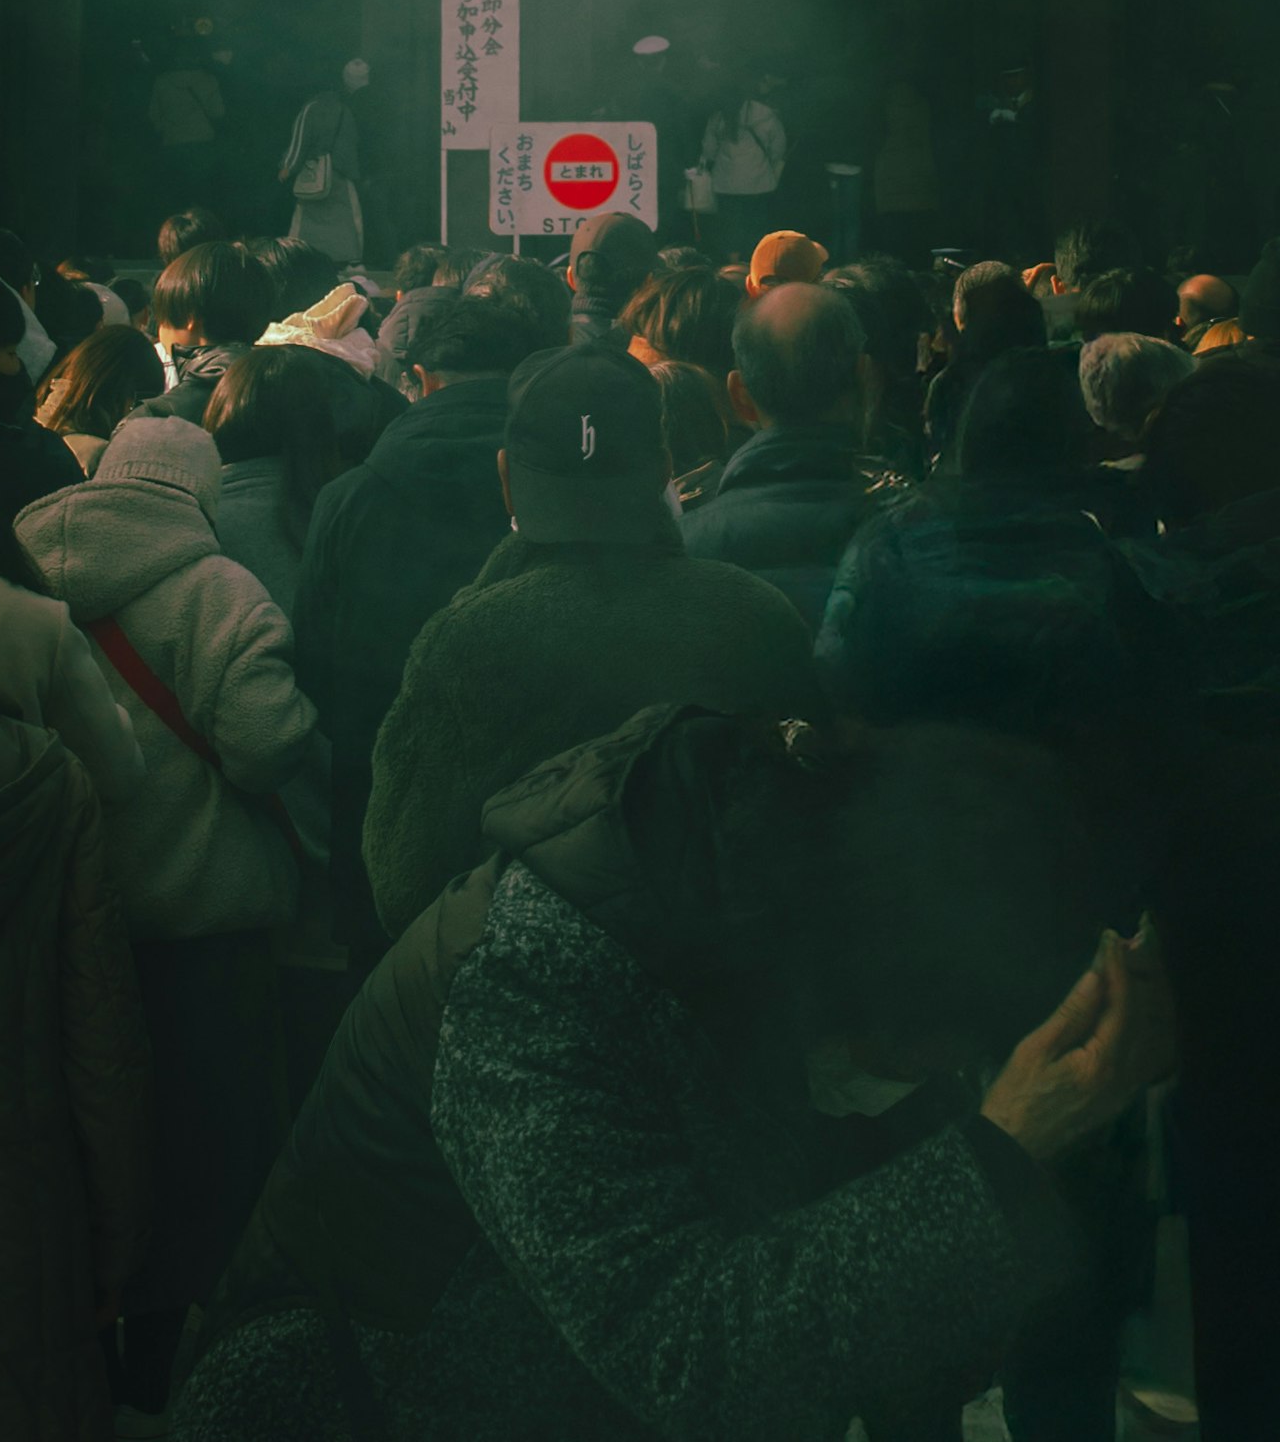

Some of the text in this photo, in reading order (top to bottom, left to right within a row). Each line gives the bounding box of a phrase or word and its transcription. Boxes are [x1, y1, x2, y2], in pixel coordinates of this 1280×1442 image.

[516, 133, 534, 192] おまち
[559, 164, 604, 179] とまれ
[627, 133, 646, 211] しばらく
